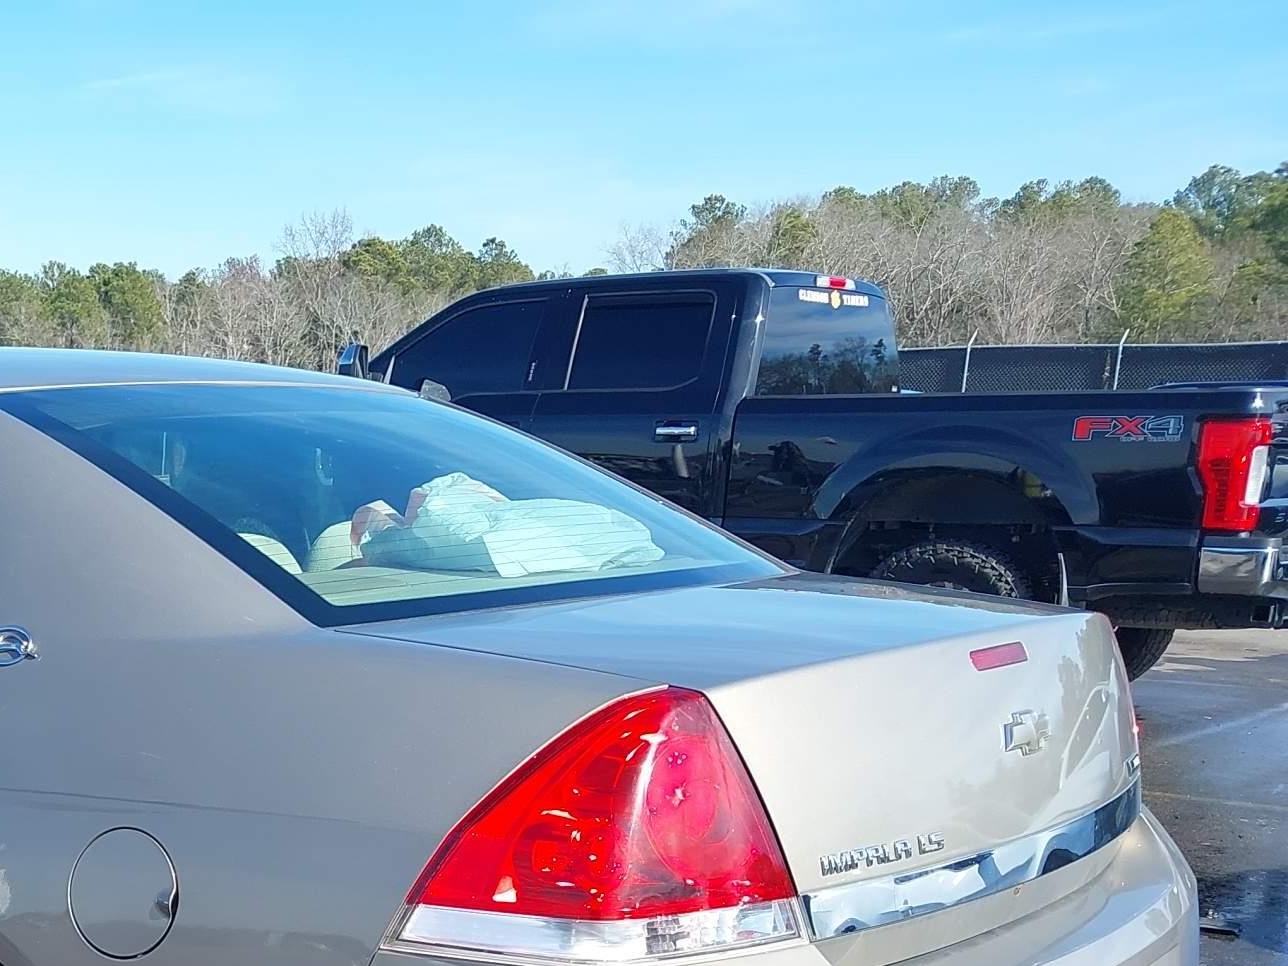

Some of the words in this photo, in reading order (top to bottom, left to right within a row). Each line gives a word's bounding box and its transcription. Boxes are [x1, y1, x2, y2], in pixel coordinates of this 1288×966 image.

[1072, 415, 1184, 441] FX4
[820, 839, 913, 876] IMPALA
[916, 831, 945, 856] LS
